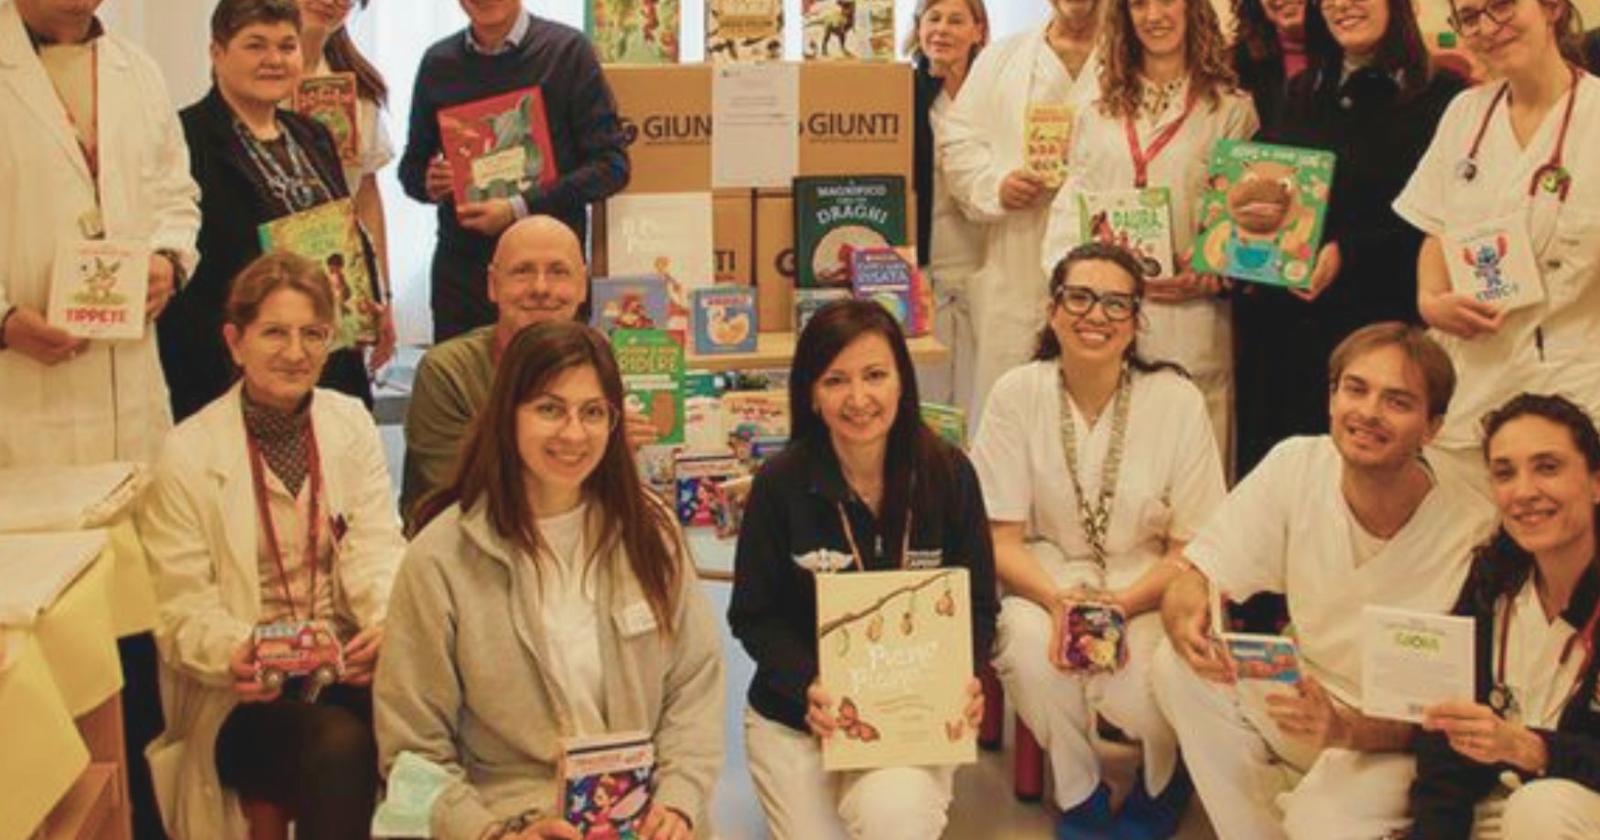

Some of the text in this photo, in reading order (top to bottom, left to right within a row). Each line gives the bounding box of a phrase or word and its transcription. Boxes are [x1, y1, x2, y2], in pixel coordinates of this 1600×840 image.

[643, 114, 712, 139] GIUN
[807, 111, 898, 136] GIUNTI
[816, 185, 888, 197] MAGNIFICO
[815, 202, 888, 224] DRAGHI
